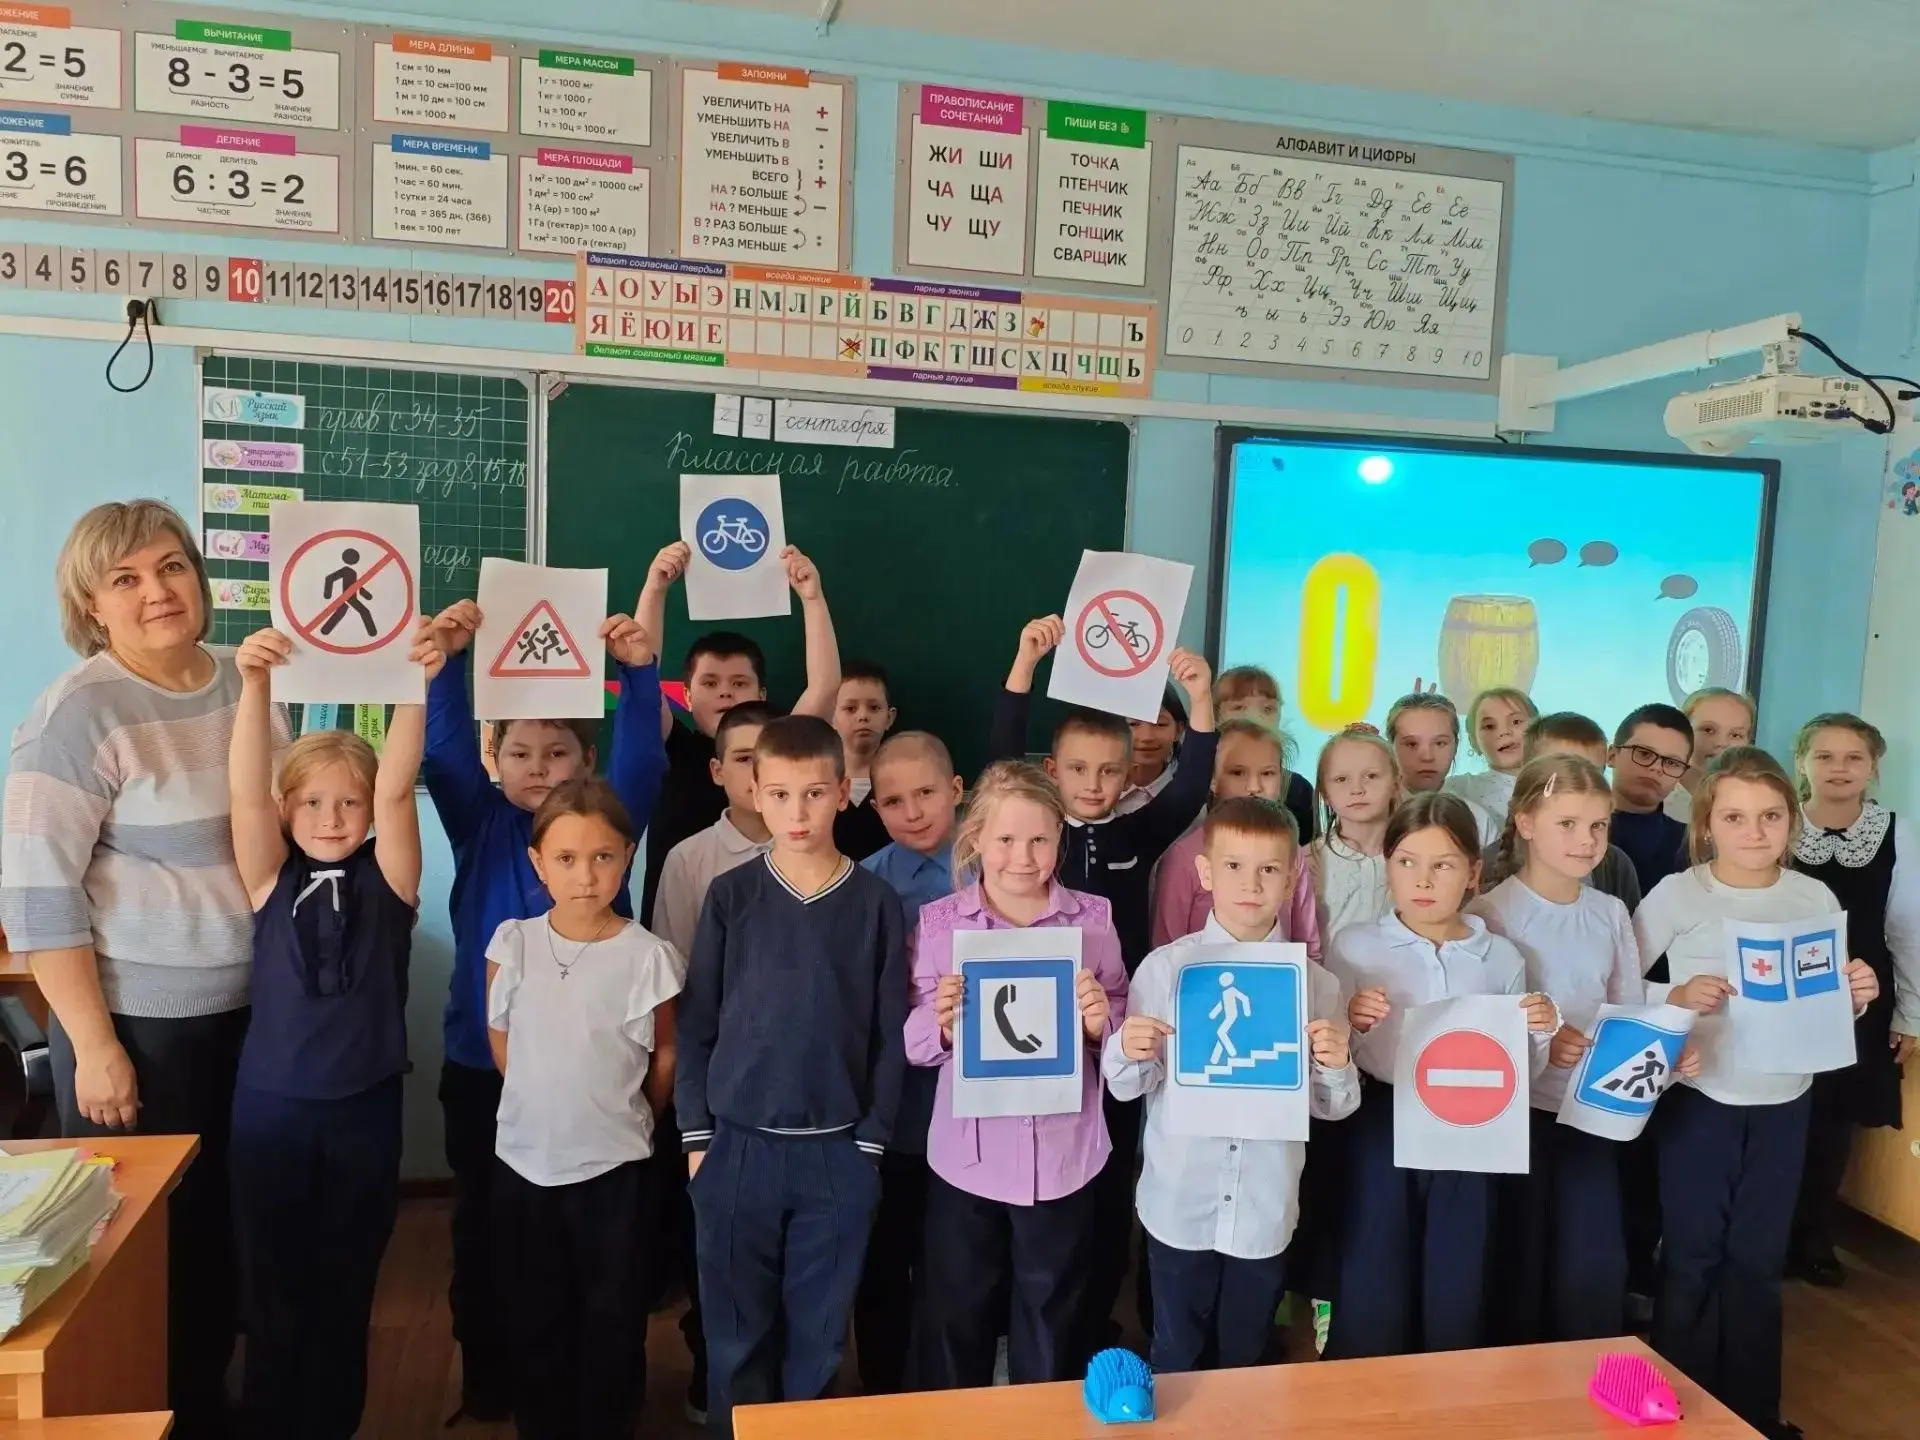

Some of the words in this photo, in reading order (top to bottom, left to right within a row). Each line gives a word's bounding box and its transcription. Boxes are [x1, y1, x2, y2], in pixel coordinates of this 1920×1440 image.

[204, 28, 263, 42] ВЫЧИТАНИЕ
[151, 42, 208, 55] УМЕНЬШАЕМОЕ
[214, 49, 264, 61] ВЫЧИТАЕМОЕ
[409, 40, 436, 52] МЕРА
[438, 43, 475, 56] ДЛИНЫ
[5, 42, 26, 72] 2
[64, 48, 85, 77] 5
[555, 55, 580, 66] МЕРА
[583, 58, 619, 70] МАССЫ
[396, 62, 399, 70] 1
[402, 63, 414, 72] см
[424, 65, 434, 74] 10
[437, 67, 451, 75] мм
[741, 68, 788, 81] ЗАПОМНИ
[168, 57, 190, 87] 8
[228, 64, 250, 93] 3
[282, 69, 304, 99] 5
[55, 83, 94, 92] ЗНАЧЕНИЕ
[191, 99, 229, 110] РАЗНОСТЬ
[274, 103, 311, 114] ЗНАЧЕНИЕ
[703, 95, 772, 112] УВЕЛИЧИТЬ
[774, 103, 790, 114] НА
[930, 93, 1014, 113] ПРАВОПИСАНИЕ
[274, 112, 312, 122] РАЗНОСТИ
[697, 113, 771, 129] УМЕНЬШИТЬ
[774, 120, 790, 131] НА
[940, 109, 1003, 125] СОЧЕТАНИЙ
[1065, 117, 1097, 130] ПИШИ
[1099, 120, 1118, 132] БЕЗ
[216, 134, 261, 147] ДЕЛЕНИЕ
[403, 139, 429, 151] МЕРА
[432, 141, 478, 154] ВРЕМЕНИ
[711, 131, 779, 147] УВЕЛИЧИТЬ
[782, 139, 790, 149] В
[165, 151, 202, 161] ДЕЛИМОЕ
[219, 156, 258, 166] ДЕЛИТЕЛЬ
[706, 148, 779, 165] УМЕНЬШИТЬ
[782, 156, 789, 166] В
[929, 145, 962, 164] ЖИ
[979, 150, 1012, 170] ШИ
[1276, 136, 1345, 157] АЛФАВИТ
[1349, 147, 1359, 158] И
[1362, 148, 1416, 165] ЦИФРЫ
[544, 152, 570, 164] МЕРА
[572, 154, 622, 168] ПЛОЩАДИ
[1071, 153, 1119, 171] ТОЧКА
[6, 151, 28, 181] 3
[65, 156, 87, 186] 6
[752, 170, 789, 183] ВСЕГО
[172, 165, 195, 194] 6
[228, 170, 250, 199] 3
[283, 175, 305, 204] 2
[711, 184, 727, 194] НА
[731, 187, 737, 195] ?
[740, 187, 788, 201] БОЛЬШЕ
[928, 179, 954, 198] ЧА
[970, 184, 1003, 204] ЩА
[1059, 175, 1128, 195] ПТЕНЧИК
[56, 192, 96, 200] ЗНАЧЕНИЕ
[395, 191, 398, 200] 1
[400, 193, 427, 203] сутки
[437, 194, 450, 204] 24
[46, 200, 107, 210] ПРОИЗВЕДЕНИЯ
[196, 207, 231, 216] ЧАСТНОЕ
[710, 202, 726, 212] НА
[730, 203, 735, 212] ?
[738, 204, 788, 218] МЕНЬШЕ
[1063, 200, 1122, 218] ПЕЧНИК
[275, 209, 312, 219] ЗНАЧЕНИЕ
[275, 218, 313, 227] ЧАСТНОГО
[395, 223, 398, 231] 1
[427, 224, 442, 234] 100
[445, 227, 461, 235] лет
[694, 218, 701, 227] В
[705, 218, 710, 228] ?
[714, 219, 736, 230] РАЗ
[739, 222, 788, 235] БОЛЬШЕ
[927, 214, 952, 232] ЧУ
[969, 218, 1001, 239] ЩУ
[1059, 224, 1123, 243] ГОНЩИК
[693, 235, 700, 245] В
[704, 236, 709, 246] ?
[712, 236, 734, 248] РАЗ
[737, 239, 787, 252] МЕНЬШЕ
[1053, 247, 1126, 266] СВАРЩИК
[590, 254, 627, 267] делают
[629, 259, 678, 271] согласный
[680, 264, 723, 276] твердым
[0, 253, 17, 280] 3
[35, 254, 52, 282] 4
[70, 256, 86, 284] 5
[104, 259, 120, 287] 6
[138, 262, 154, 288] 7
[172, 263, 187, 291] 8
[205, 265, 221, 292] 9
[232, 267, 260, 296] 10
[266, 271, 291, 297] 11
[296, 272, 323, 299] 12
[328, 274, 356, 301] 13
[360, 276, 388, 303] 14
[392, 278, 419, 305] 15
[424, 280, 450, 307] 16
[454, 282, 482, 309] 17
[486, 283, 512, 311] 18
[517, 285, 543, 313] 19
[547, 288, 574, 315] 20
[765, 271, 796, 284] всегда
[798, 275, 831, 284] звонкие
[914, 285, 945, 297] парные
[948, 288, 980, 297] звонкие
[594, 345, 630, 357] делают
[633, 348, 681, 360] согласный
[684, 352, 716, 363] мягким
[913, 372, 943, 382] парные
[946, 375, 973, 384] глухие
[1043, 381, 1071, 392] всегда
[1073, 384, 1099, 393] глухие
[247, 398, 288, 413] Русский
[253, 410, 279, 421] язык
[664, 431, 829, 476] Классная
[247, 457, 284, 468] чтение
